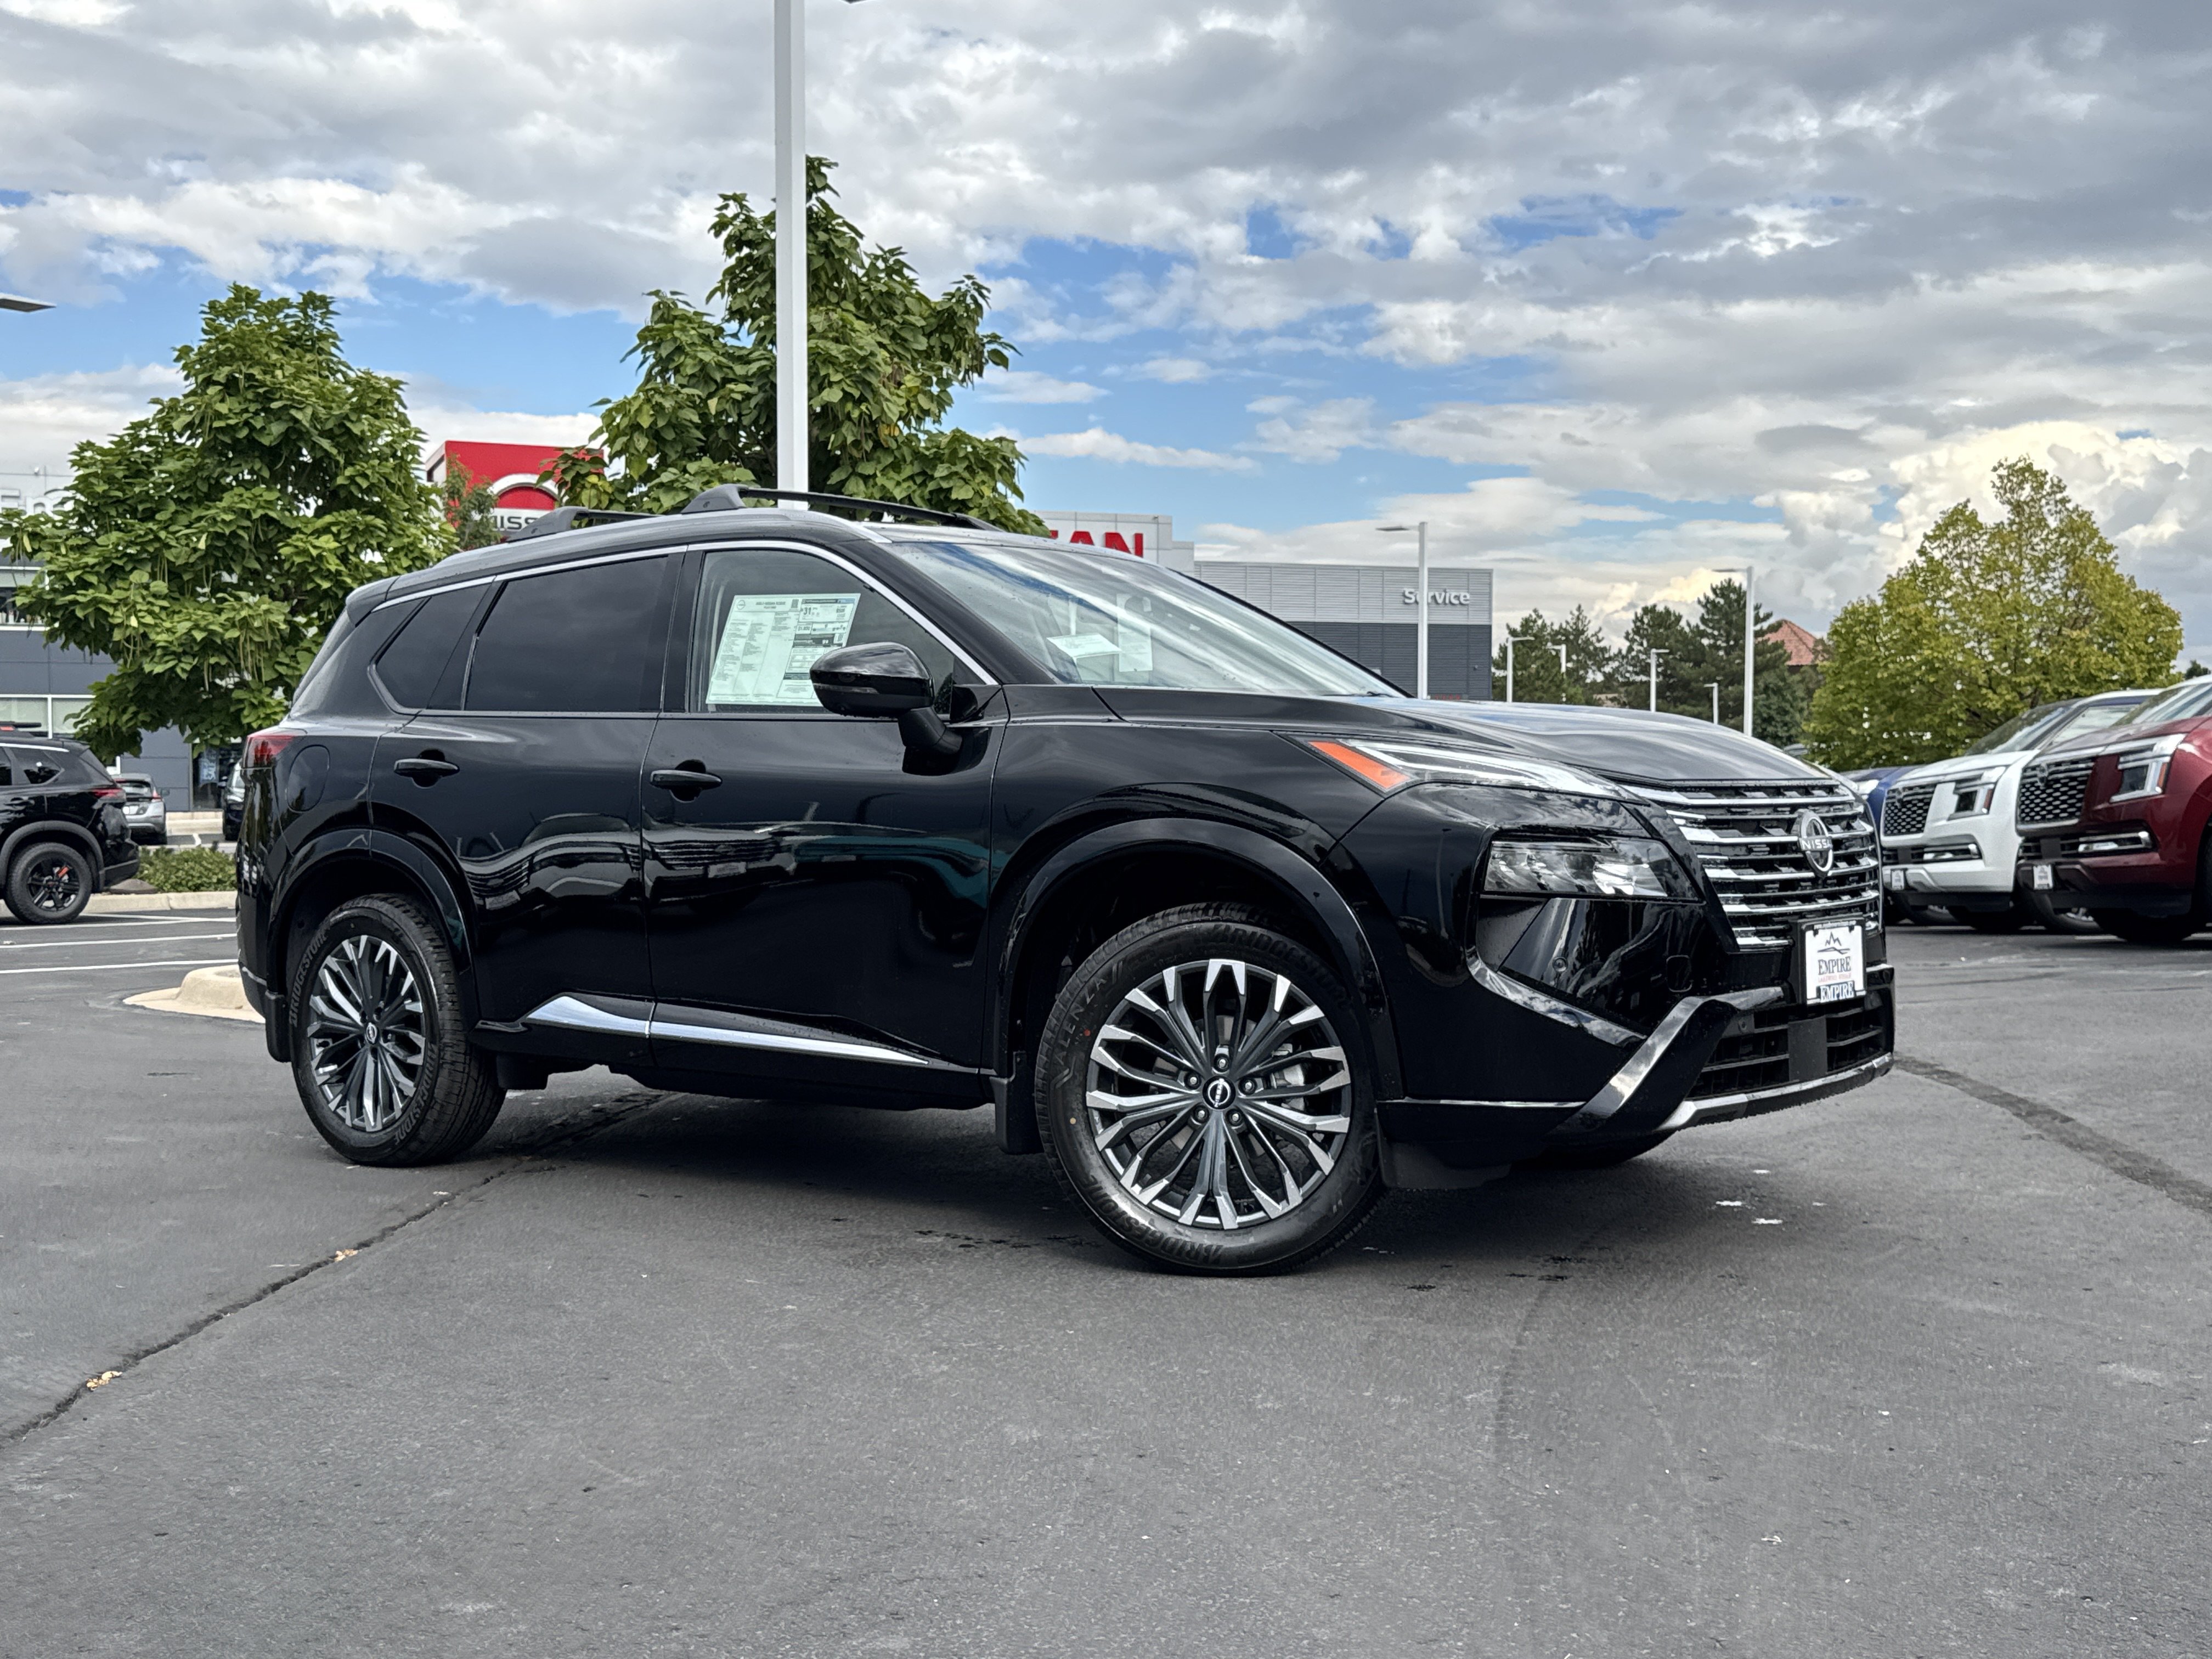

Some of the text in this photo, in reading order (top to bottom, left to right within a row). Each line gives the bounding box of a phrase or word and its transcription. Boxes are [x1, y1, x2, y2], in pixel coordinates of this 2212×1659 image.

[1403, 588, 1470, 605] Srvice
[1818, 956, 1852, 975] EMPIRE
[1820, 981, 1854, 1003] EMPIRE
[1054, 978, 1105, 1066] ALENZA
